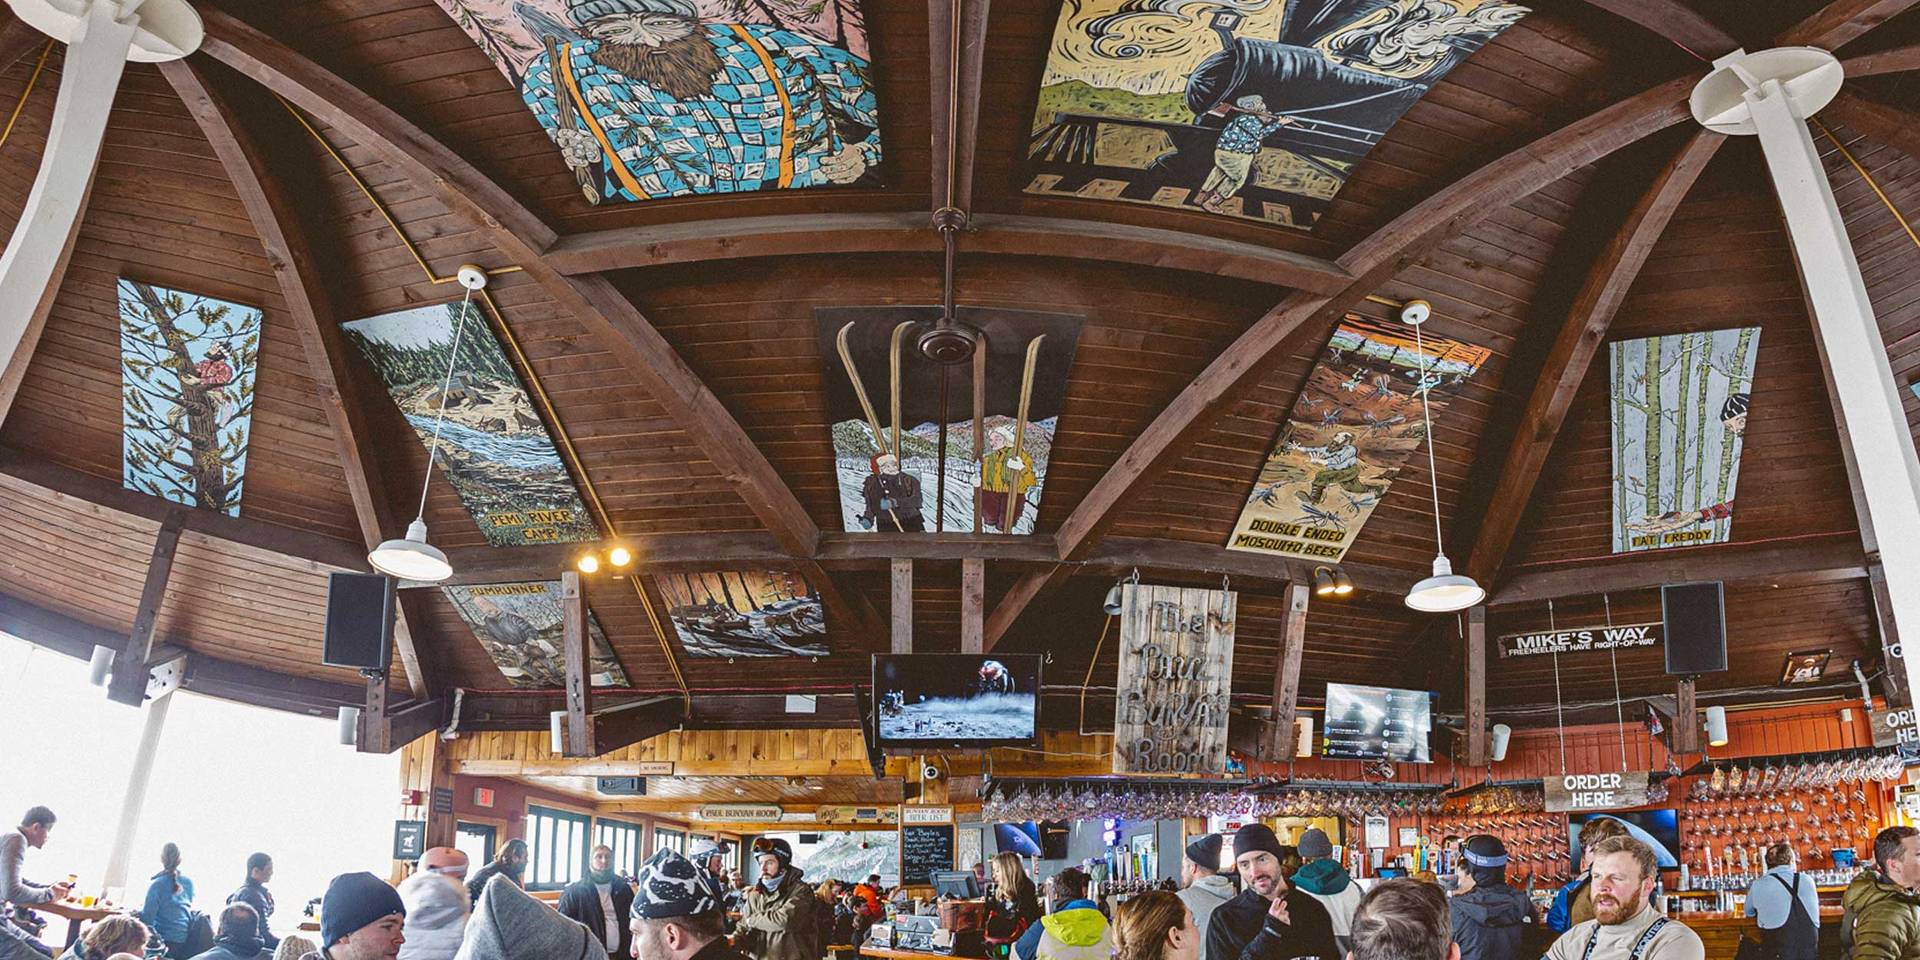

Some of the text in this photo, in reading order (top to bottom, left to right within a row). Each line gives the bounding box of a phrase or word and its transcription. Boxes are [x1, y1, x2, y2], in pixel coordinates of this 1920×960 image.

[490, 510, 572, 526] PEMI RIVER
[522, 528, 558, 540] CAMP
[1249, 520, 1346, 542] DOUBLE ENDED
[1632, 530, 1712, 547] FAT FREDDY
[1304, 545, 1345, 557] BEES!
[469, 584, 547, 596] RUMRUNNER
[1516, 626, 1650, 649] MIKE'S WAY
[1508, 638, 1656, 656] FREEHEELERS HAVE RIGHT-OF-WAY
[1886, 710, 1917, 728] ORD
[1896, 726, 1919, 743] HE
[1563, 773, 1621, 790] ORDER
[1572, 791, 1616, 807] HERE
[705, 809, 777, 818] PAUL BUNYAN ROOM
